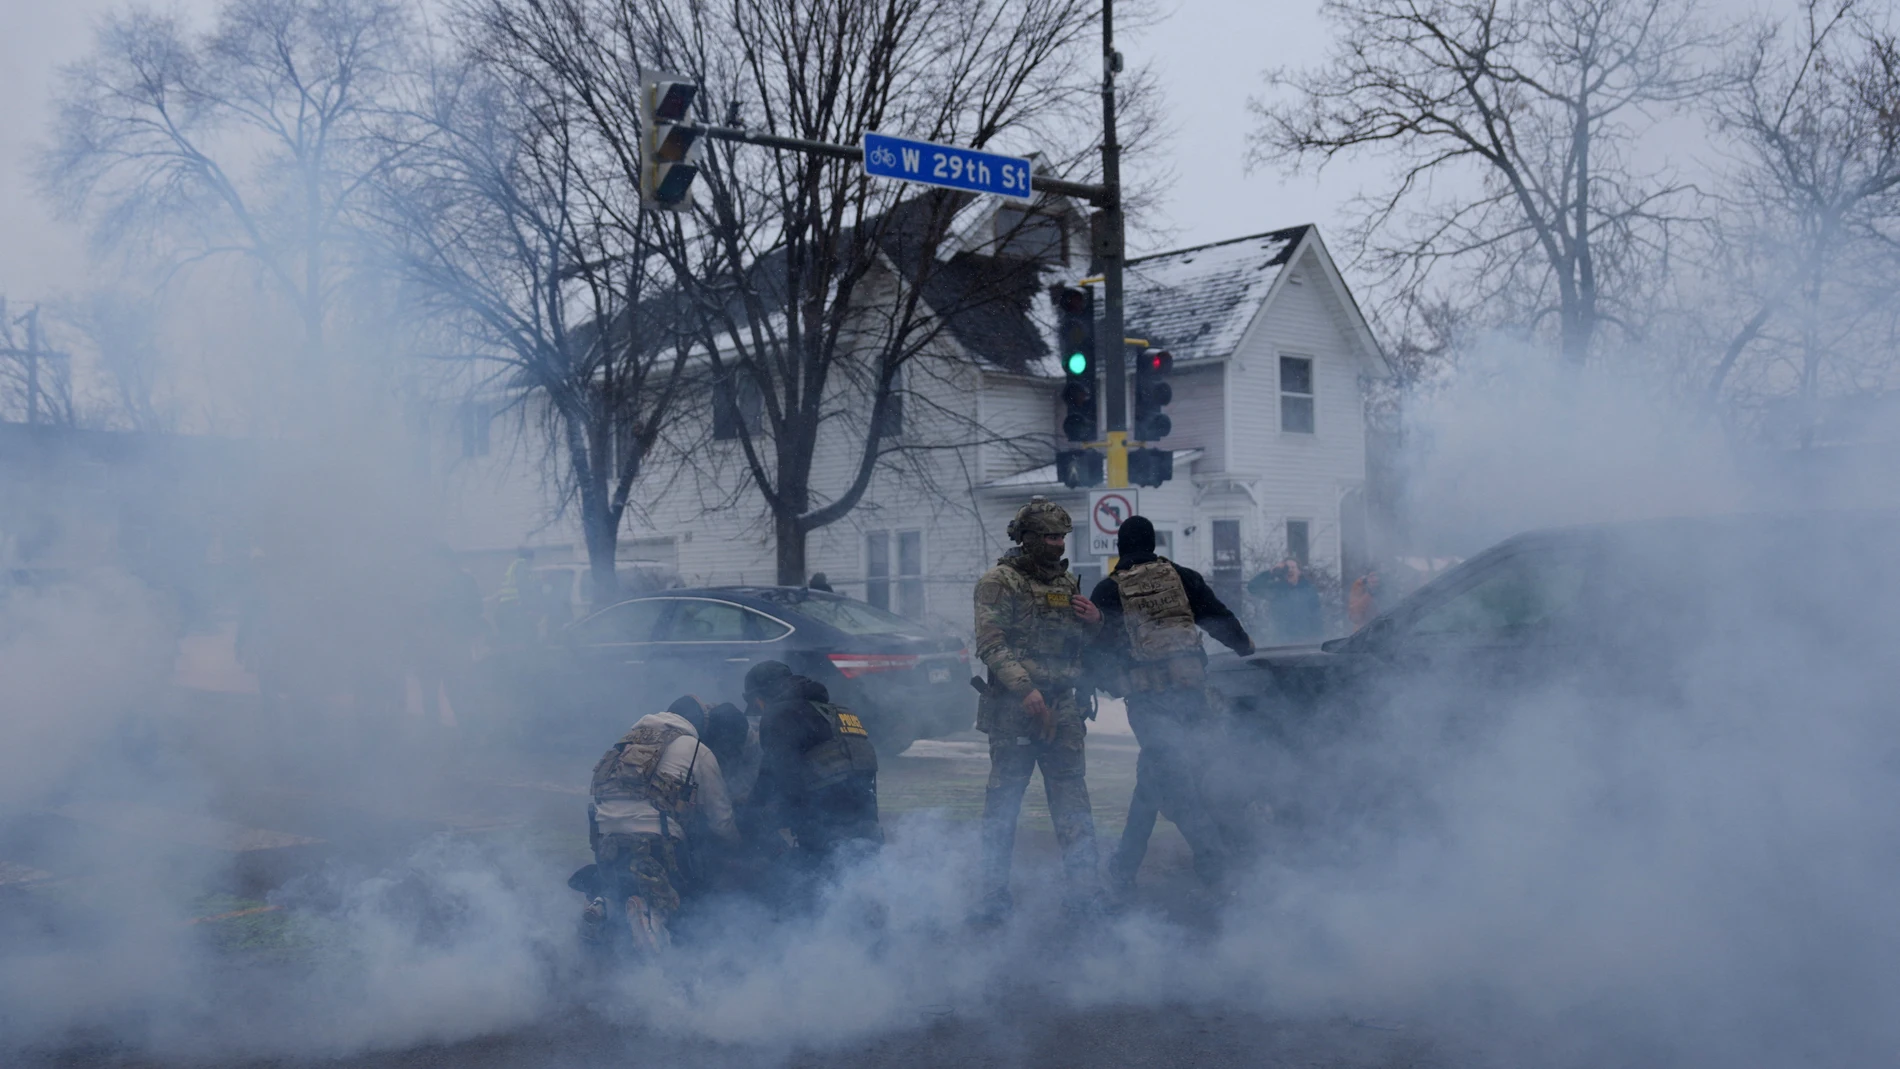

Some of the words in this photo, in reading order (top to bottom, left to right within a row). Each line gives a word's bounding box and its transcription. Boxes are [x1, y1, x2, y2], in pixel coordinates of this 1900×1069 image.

[902, 147, 920, 173] W
[933, 153, 991, 185] 29th
[1002, 164, 1026, 190] St
[1093, 539, 1108, 549] ON
[1138, 594, 1178, 611] POLICE
[838, 713, 863, 729] POLICE
